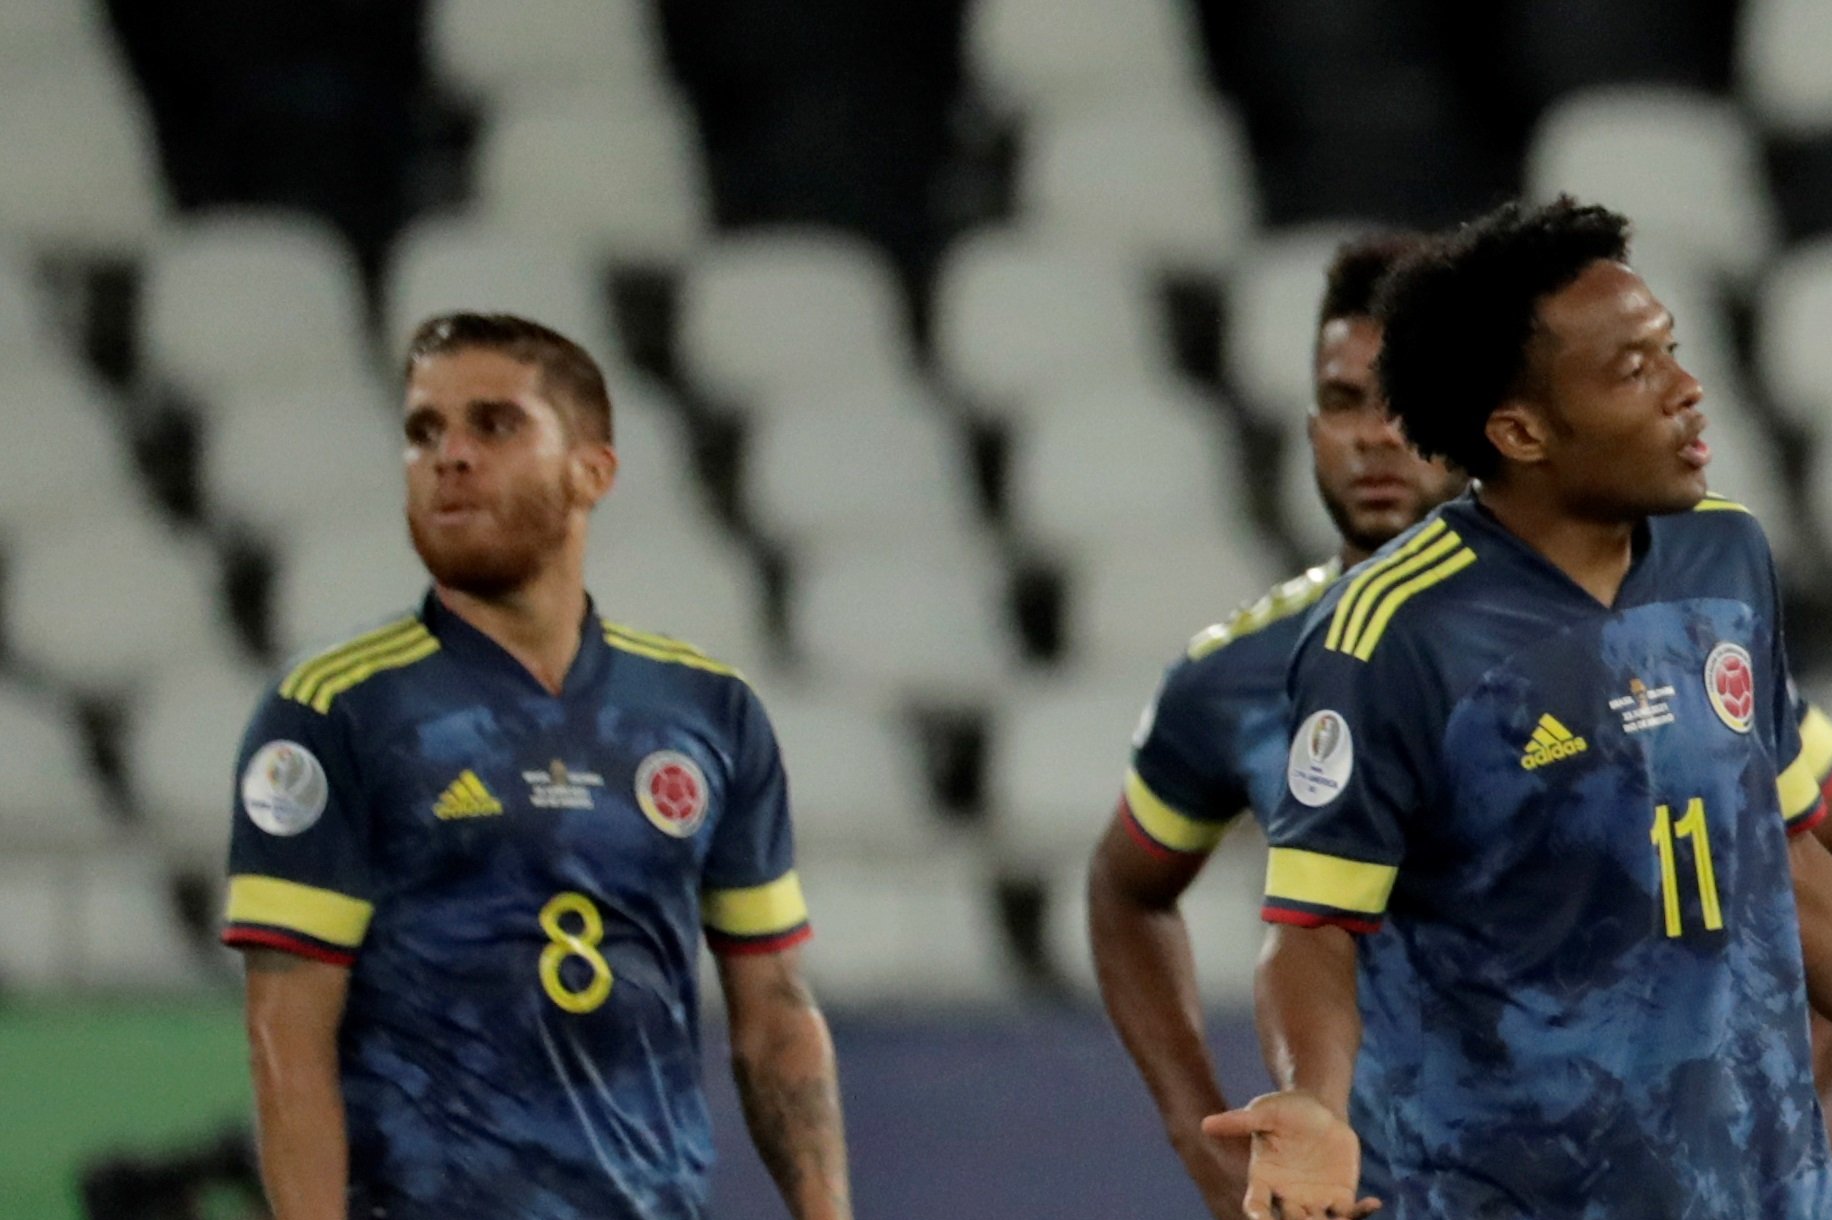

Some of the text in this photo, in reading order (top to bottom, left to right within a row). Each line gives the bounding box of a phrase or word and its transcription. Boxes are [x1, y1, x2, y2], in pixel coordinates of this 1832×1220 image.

[1521, 736, 1589, 770] adidas
[1650, 797, 1724, 938] 11
[537, 891, 614, 1014] 8
